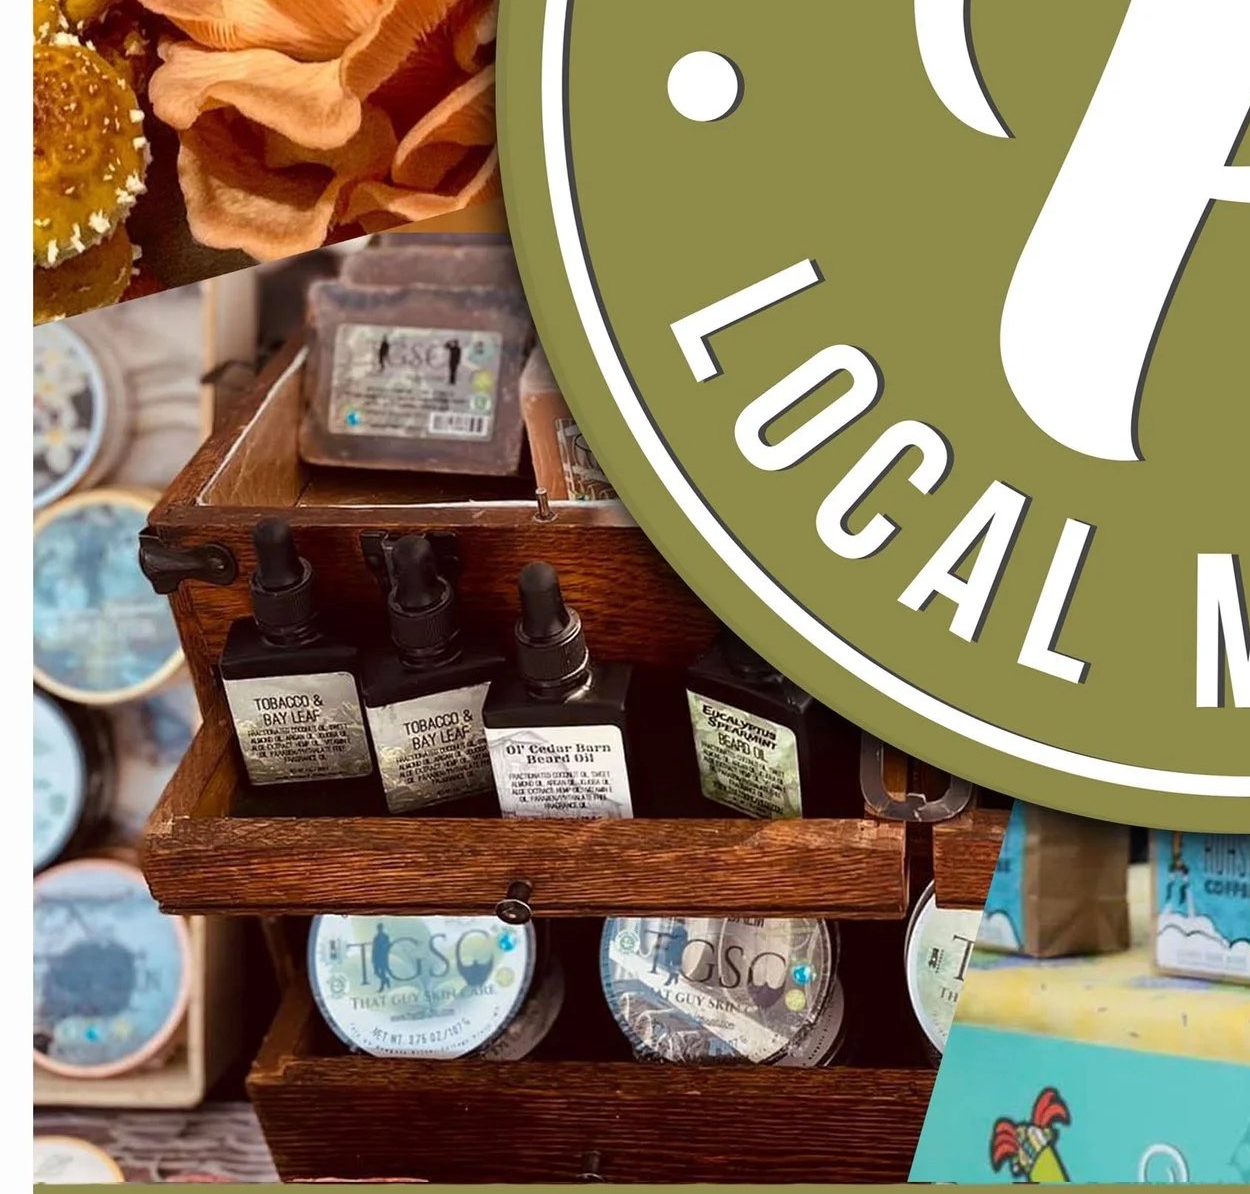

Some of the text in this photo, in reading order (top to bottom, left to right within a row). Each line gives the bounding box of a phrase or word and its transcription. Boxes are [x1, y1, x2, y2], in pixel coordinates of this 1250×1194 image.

[254, 694, 323, 711] TOBACCO &
[263, 709, 320, 726] BAY LEAF
[403, 709, 473, 735] TOBACCO &
[412, 725, 470, 750] BAY LEAF
[528, 743, 573, 754] Cedar
[576, 743, 611, 753] Barn
[527, 752, 594, 764] Beard Oil
[352, 995, 388, 1010] THAT
[391, 991, 419, 1006] GUY
[676, 991, 705, 1007] GUY
